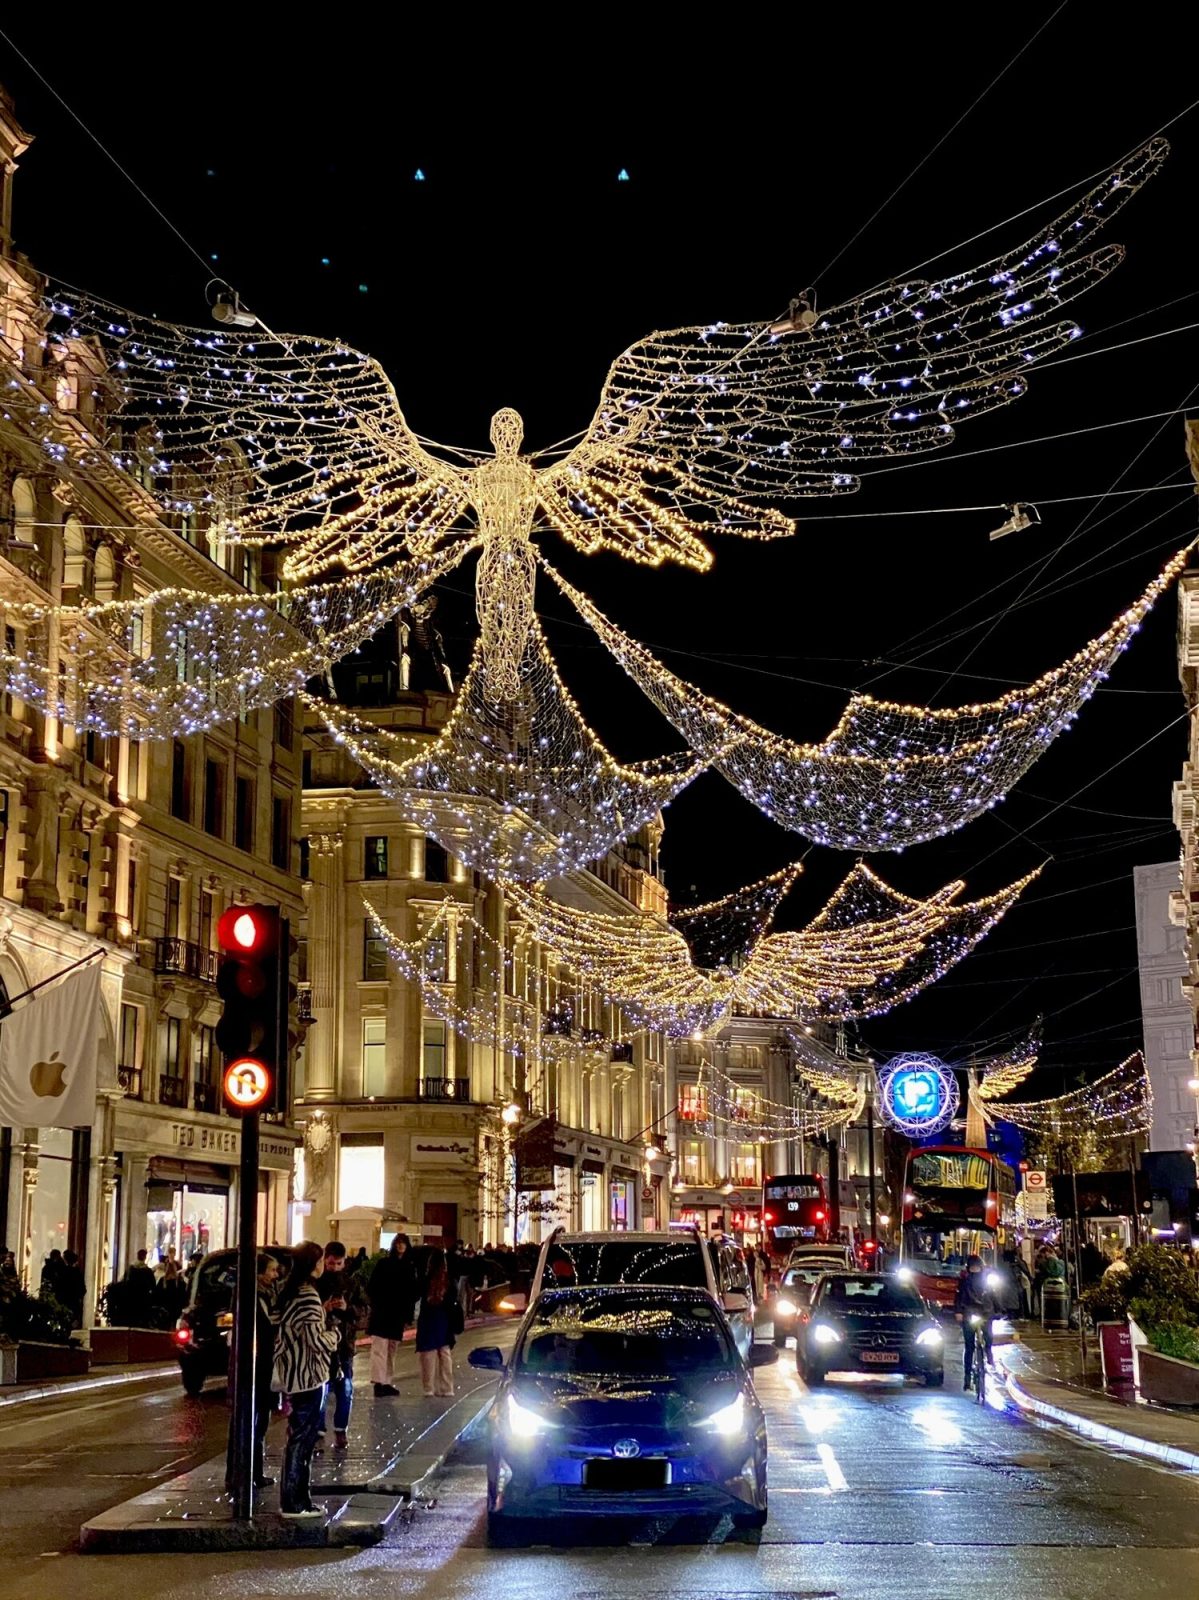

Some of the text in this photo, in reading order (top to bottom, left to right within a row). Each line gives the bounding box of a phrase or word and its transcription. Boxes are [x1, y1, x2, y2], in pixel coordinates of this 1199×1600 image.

[172, 1124, 237, 1152] TED BAKER
[787, 1201, 799, 1212] 139
